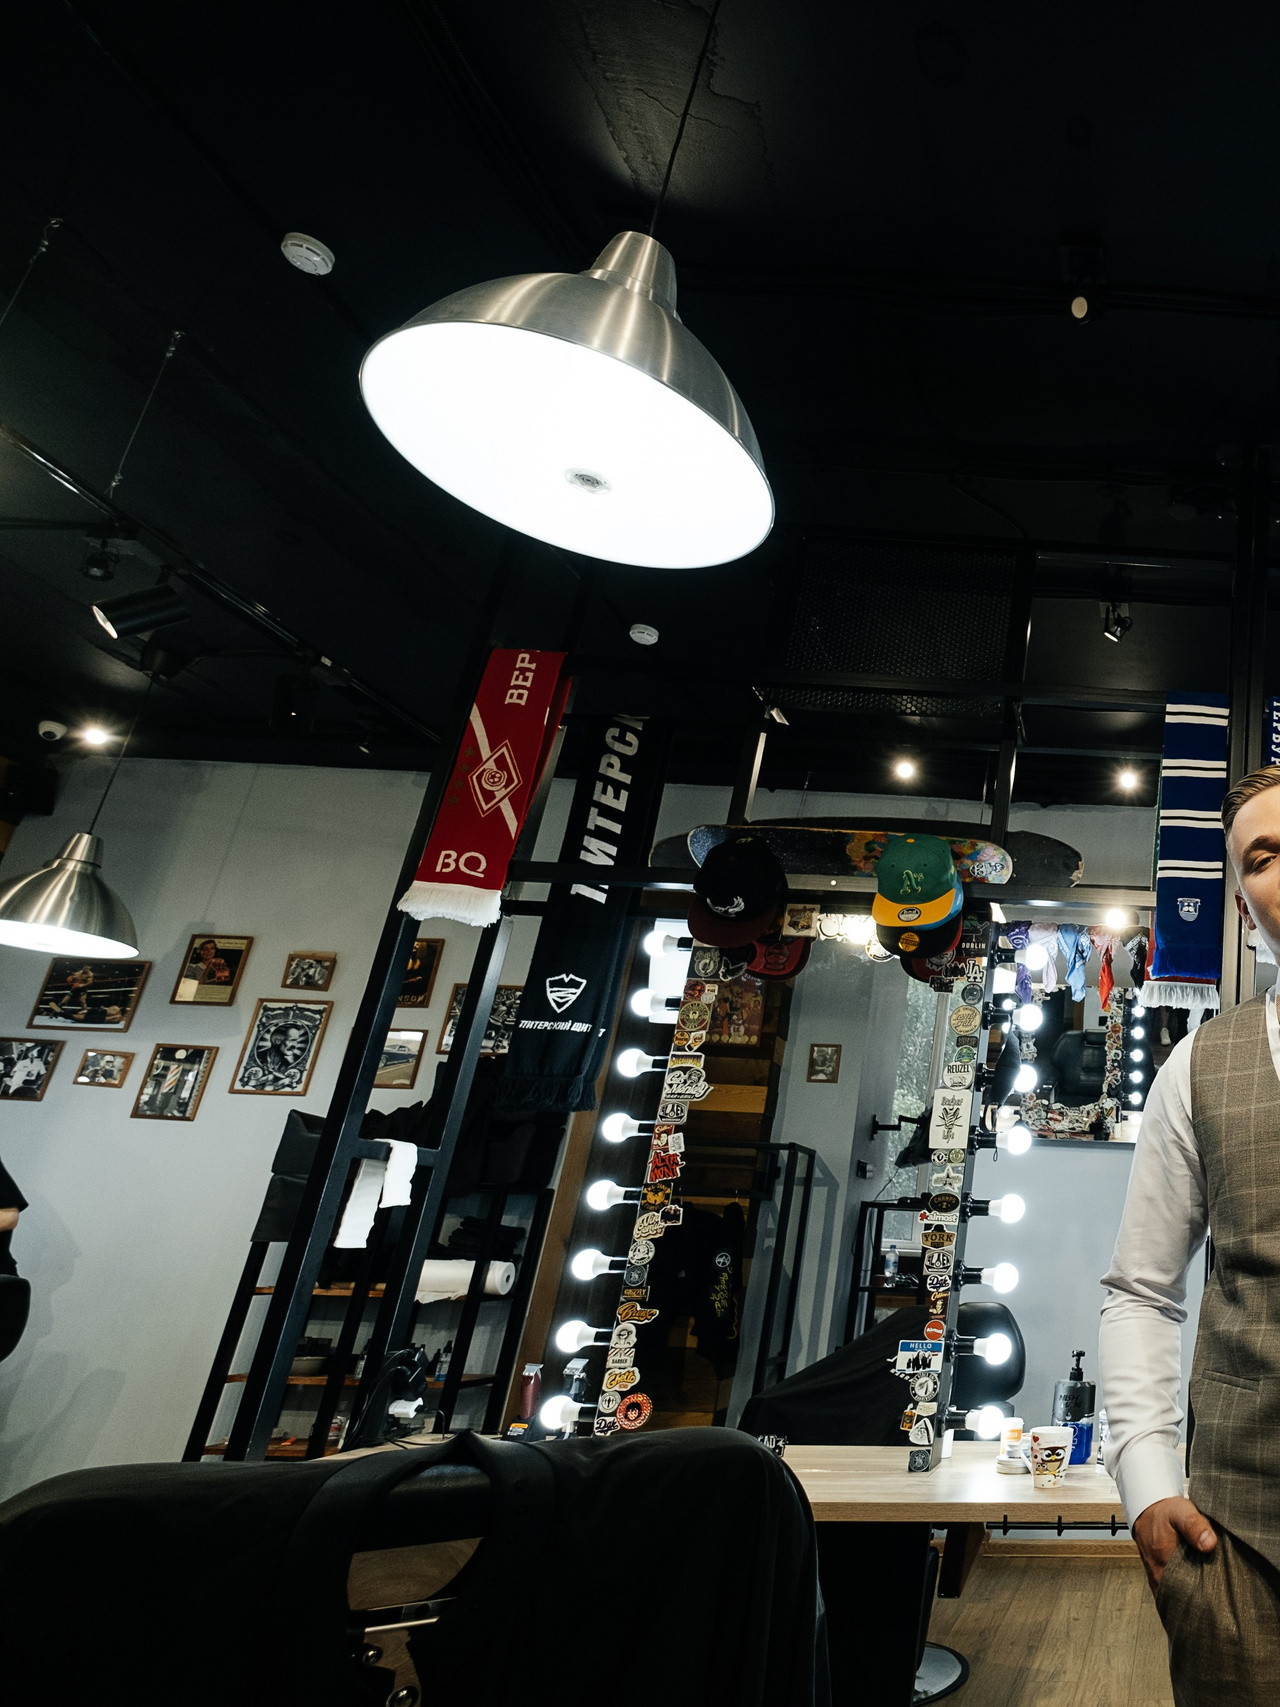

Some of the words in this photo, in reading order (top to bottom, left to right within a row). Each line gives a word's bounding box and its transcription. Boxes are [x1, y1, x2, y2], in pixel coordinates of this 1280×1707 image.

[968, 960, 983, 982] LA
[519, 1020, 572, 1031] ПИТЕРСКИЙ
[571, 1021, 593, 1032] ЩИТ
[947, 1064, 970, 1074] REUZEL
[667, 1080, 712, 1097] Monkey
[928, 1212, 958, 1222] almost
[924, 1234, 953, 1242] YORK
[606, 1370, 636, 1389] Ghetto
